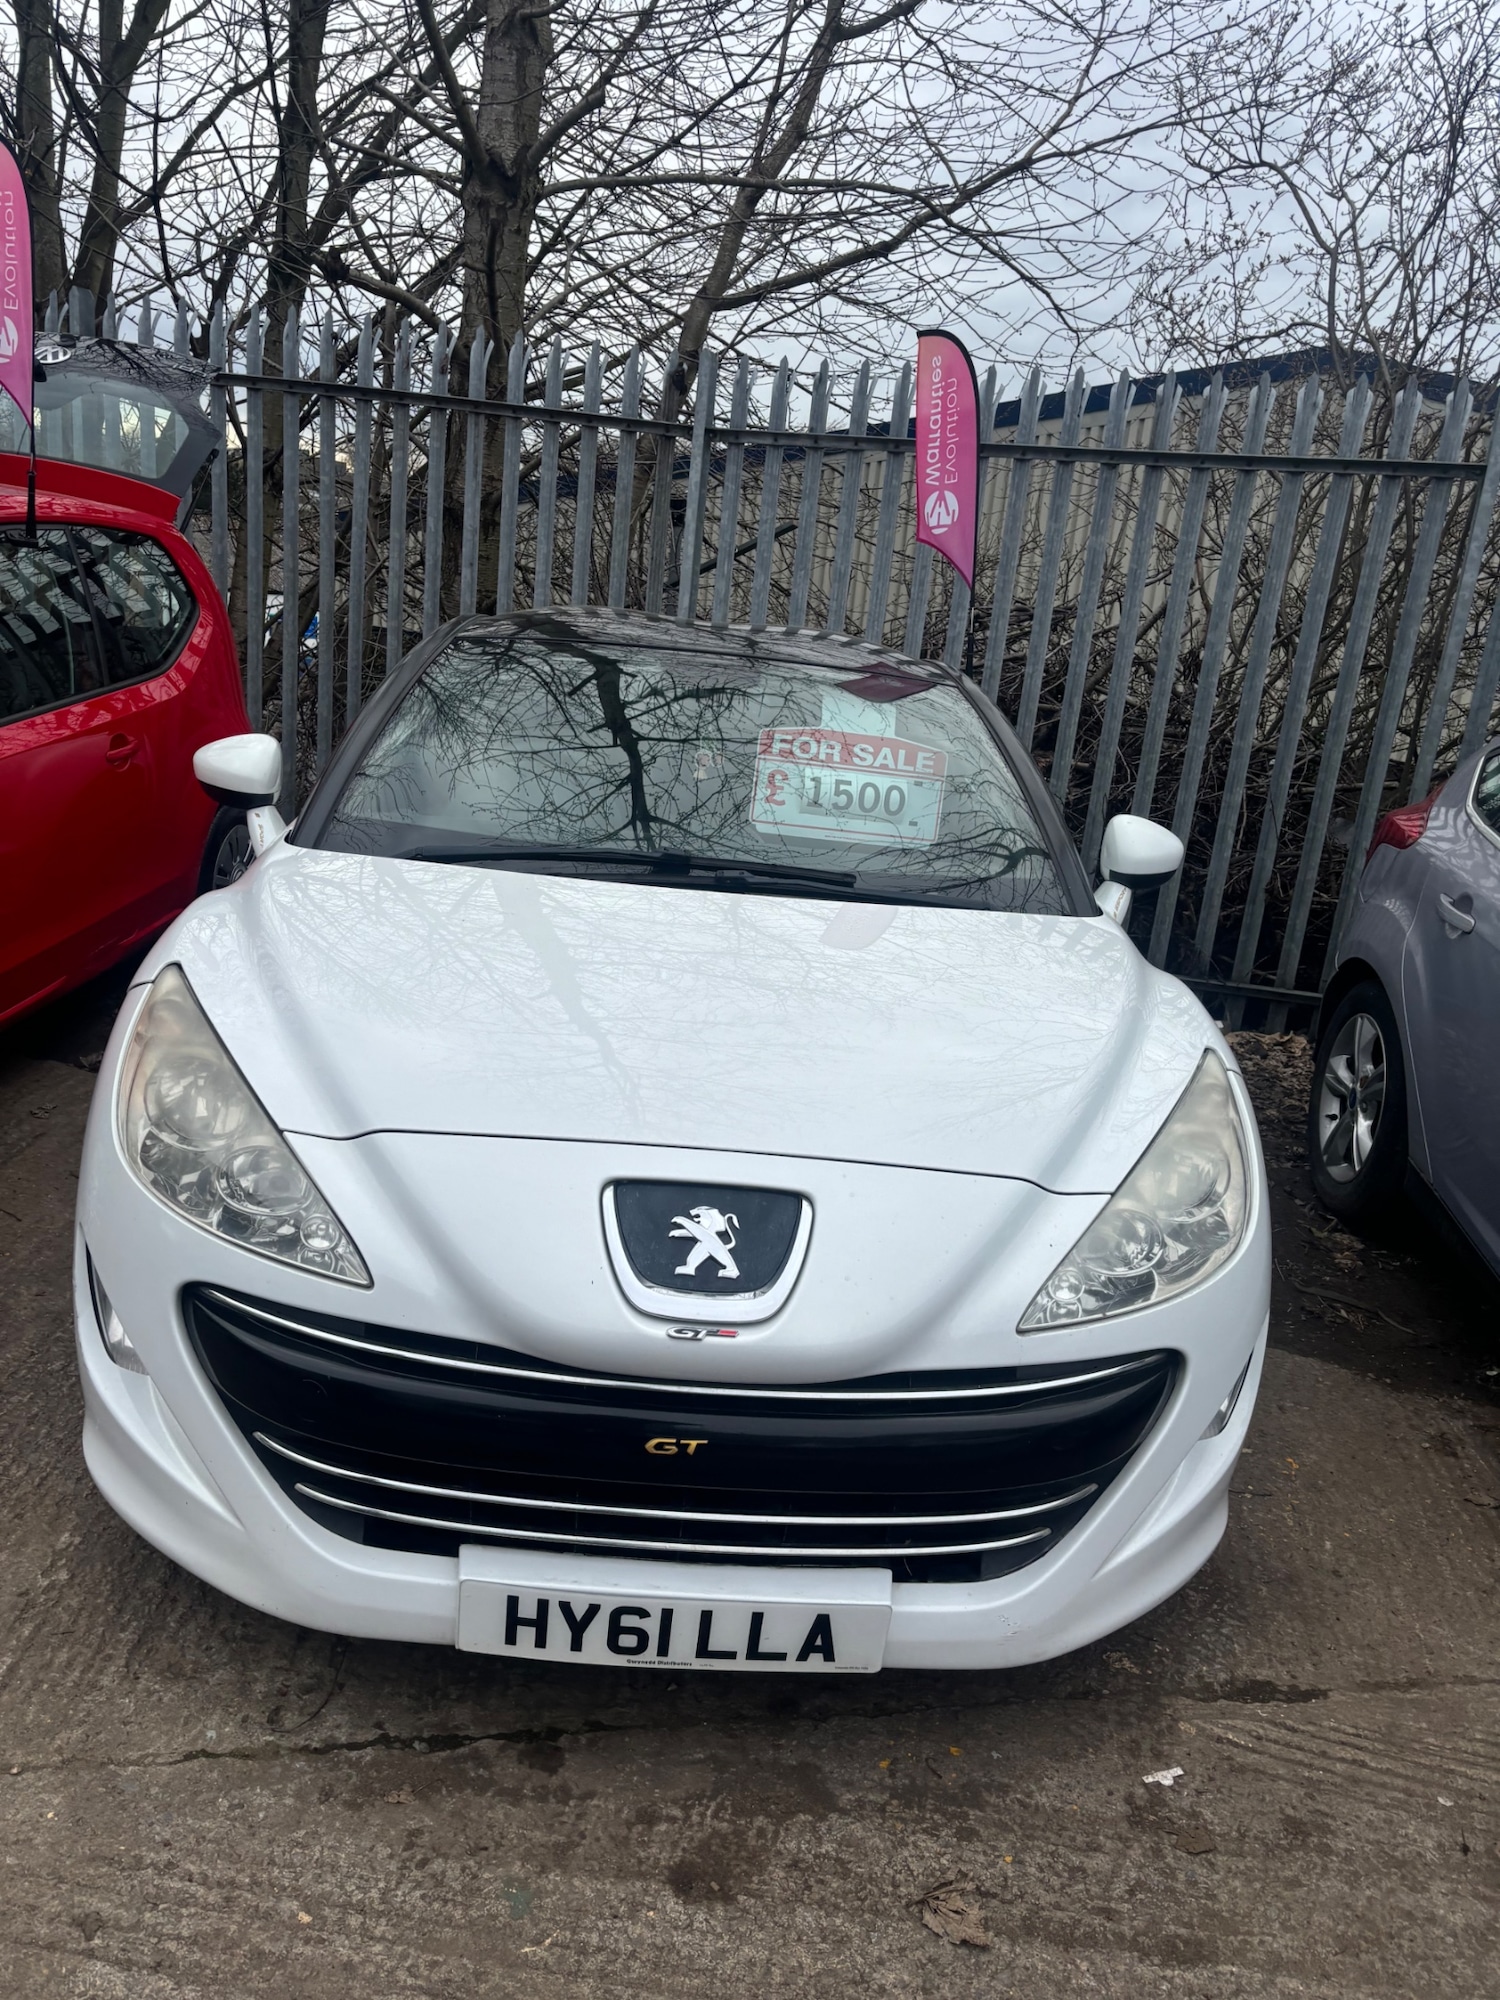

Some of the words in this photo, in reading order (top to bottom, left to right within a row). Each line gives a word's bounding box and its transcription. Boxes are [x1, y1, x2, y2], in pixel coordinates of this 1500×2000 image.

[771, 733, 843, 763] FOR
[852, 743, 937, 774] SALE
[764, 769, 789, 807] £
[804, 776, 907, 817] 1500
[644, 1437, 709, 1456] GT
[503, 1594, 675, 1658] HY61
[694, 1609, 837, 1663] LLA
